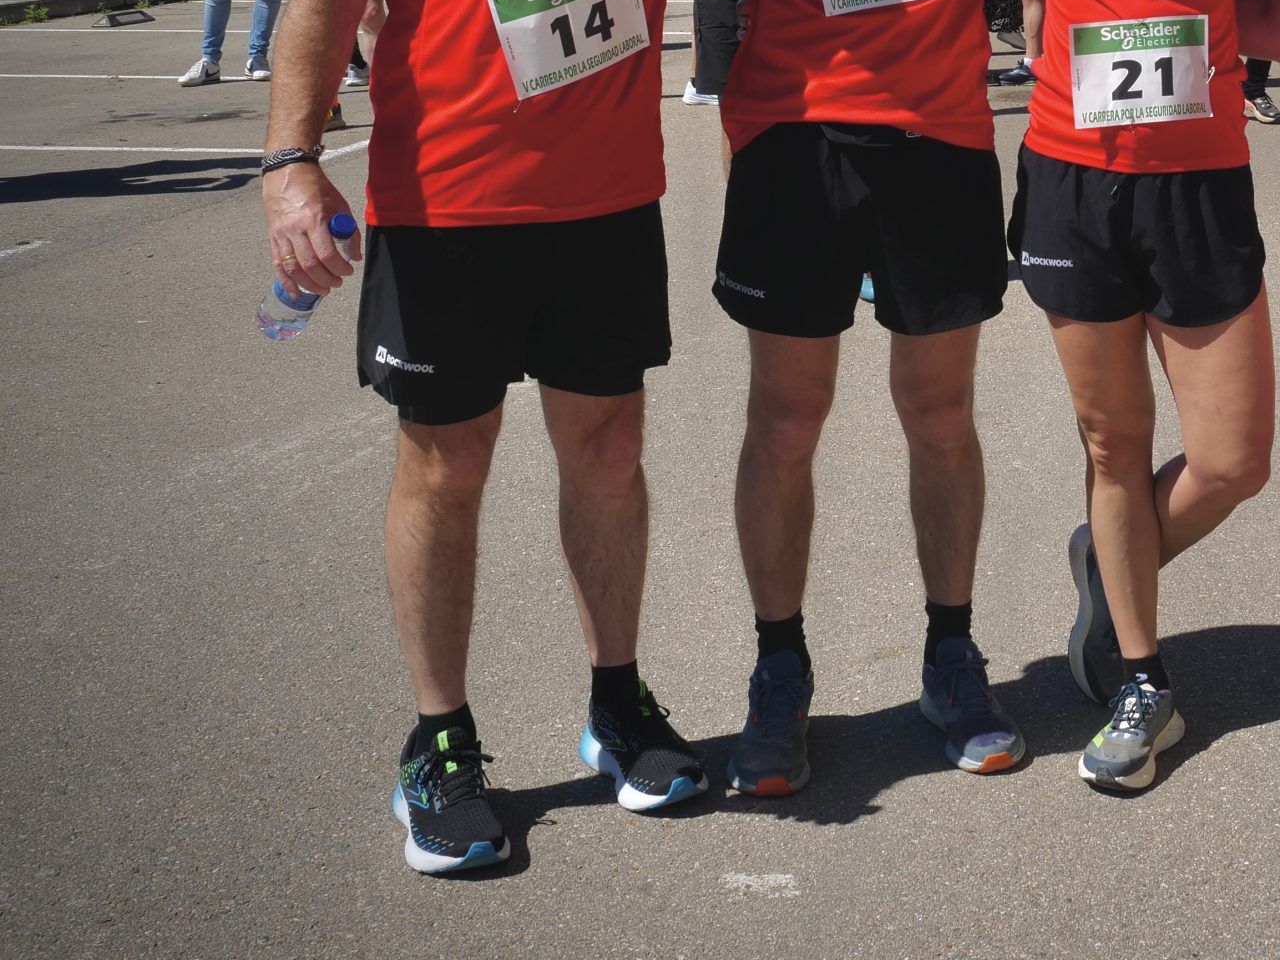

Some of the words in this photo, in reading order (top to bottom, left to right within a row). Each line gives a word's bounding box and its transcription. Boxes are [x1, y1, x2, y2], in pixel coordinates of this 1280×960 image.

[831, 0, 837, 10] V
[550, 0, 615, 59] 14
[1100, 23, 1180, 41] Schneider
[1136, 37, 1181, 47] Electric
[521, 81, 529, 93] V
[529, 70, 565, 91] CARRERA
[564, 64, 579, 80] POR
[578, 61, 587, 74] LA
[586, 45, 619, 70] SEGURIDAD
[618, 33, 644, 55] LABORAL
[1111, 56, 1174, 101] 21
[1082, 112, 1088, 123] V
[1088, 110, 1120, 123] CARRERA
[1120, 108, 1134, 120] POR
[1135, 107, 1145, 118] LA
[1145, 104, 1182, 118] SEGURIDAD
[1182, 102, 1207, 115] LABORAL
[1029, 256, 1074, 268] ROCKWOOL
[386, 353, 435, 374] ROCKWOOL
